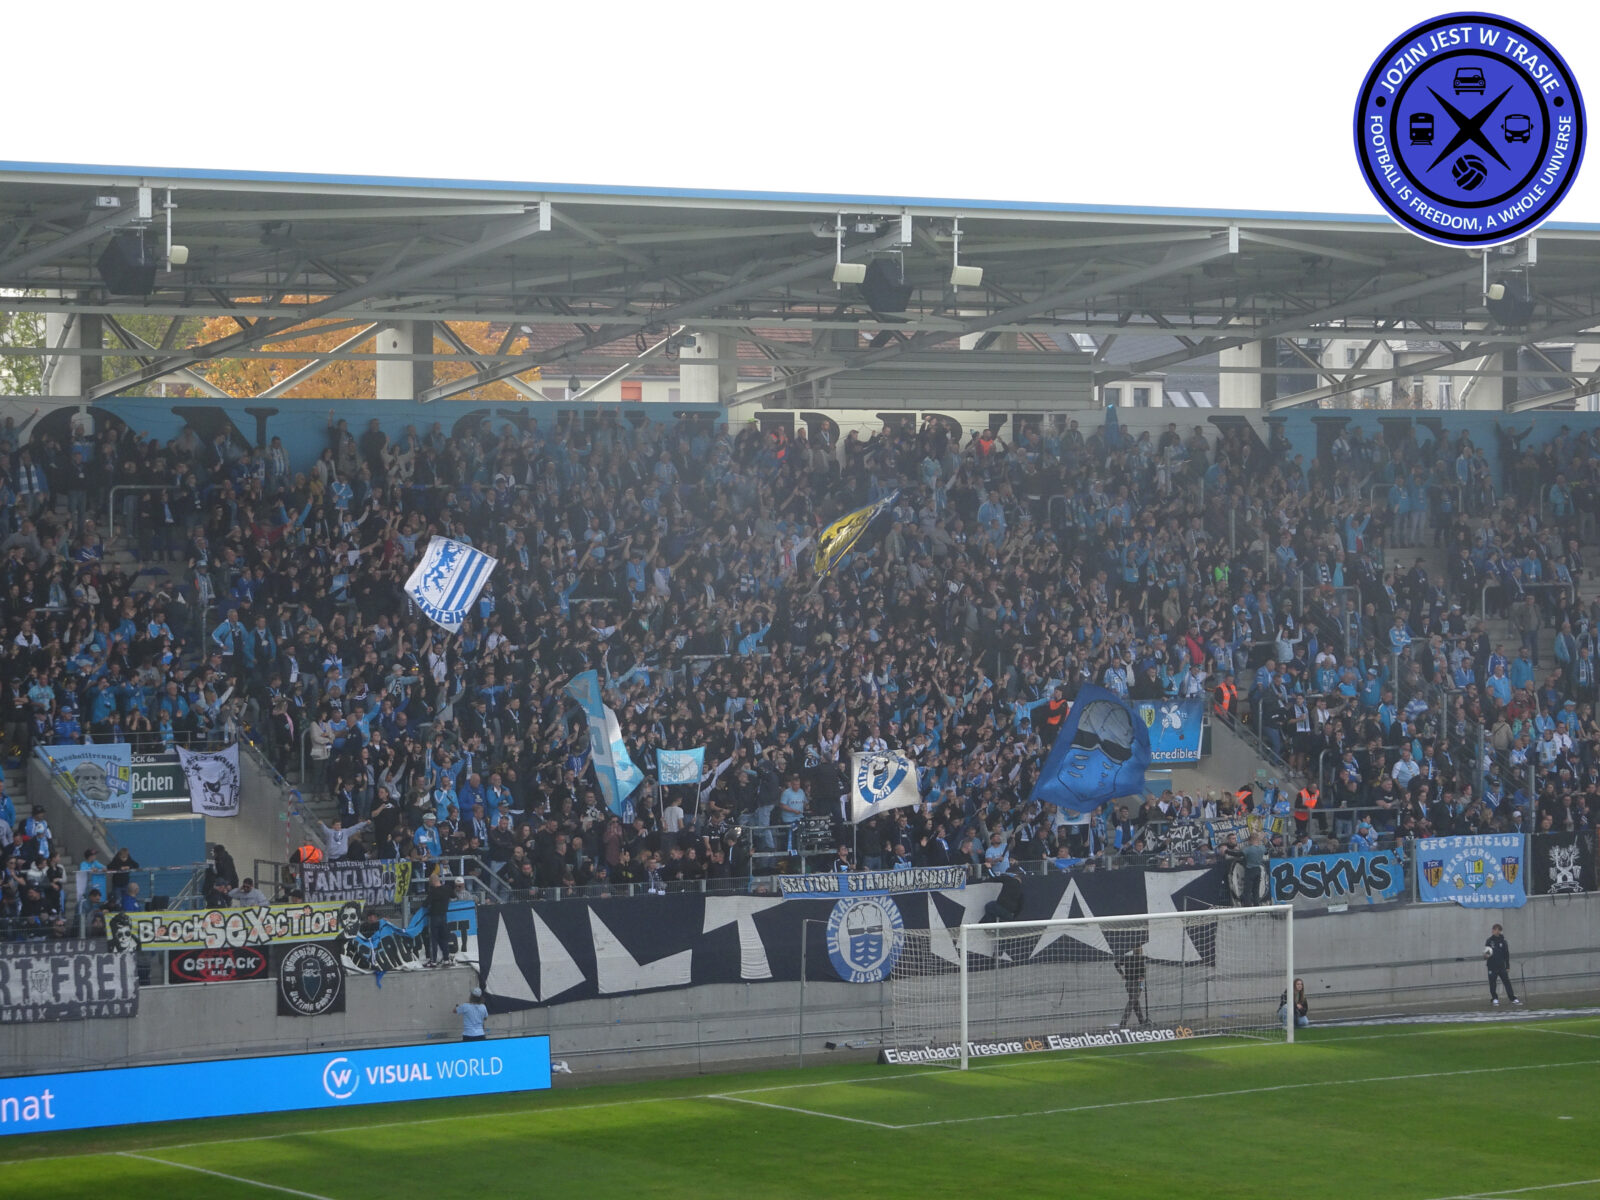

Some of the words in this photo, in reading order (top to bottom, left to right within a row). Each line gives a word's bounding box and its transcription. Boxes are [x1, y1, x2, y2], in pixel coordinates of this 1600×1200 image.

[132, 771, 174, 793] ßchen
[1420, 835, 1519, 851] CFC-FANCLUB
[304, 868, 382, 892] FANCLUB
[781, 875, 839, 893] SEKTION
[1271, 855, 1393, 901] BSKMS
[183, 957, 256, 971] OSTPACK
[50, 954, 130, 1003] FREI
[80, 1002, 133, 1017] STADT
[1047, 1030, 1137, 1050] Eisenbach
[884, 1043, 962, 1063] Eisenbach
[366, 1062, 433, 1085] VISUAL
[436, 1056, 503, 1080] WORLD
[1, 1088, 56, 1123] nat
